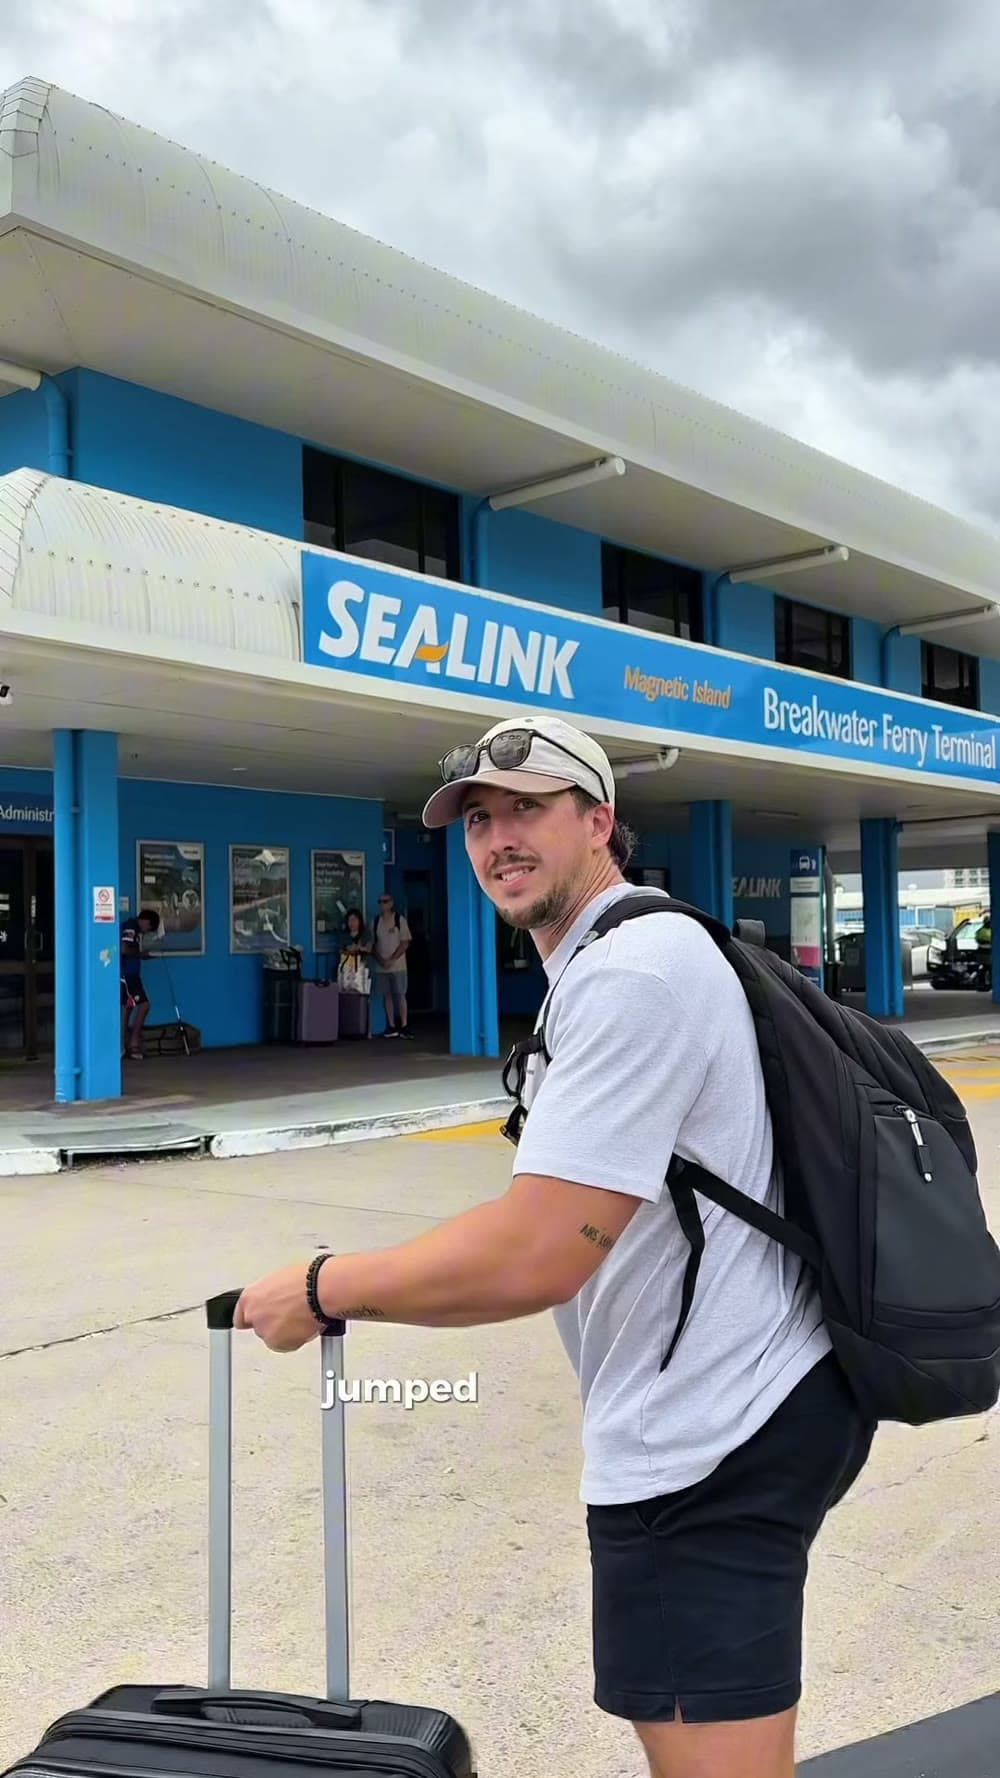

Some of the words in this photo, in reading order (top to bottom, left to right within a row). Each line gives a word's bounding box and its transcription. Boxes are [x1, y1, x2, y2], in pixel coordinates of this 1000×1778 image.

[318, 580, 580, 700] SEALINK
[624, 664, 689, 702] Magnetic
[693, 679, 732, 709] Island
[763, 687, 878, 748] Breakwater
[882, 713, 928, 768] Ferry
[931, 724, 996, 769] Terminal
